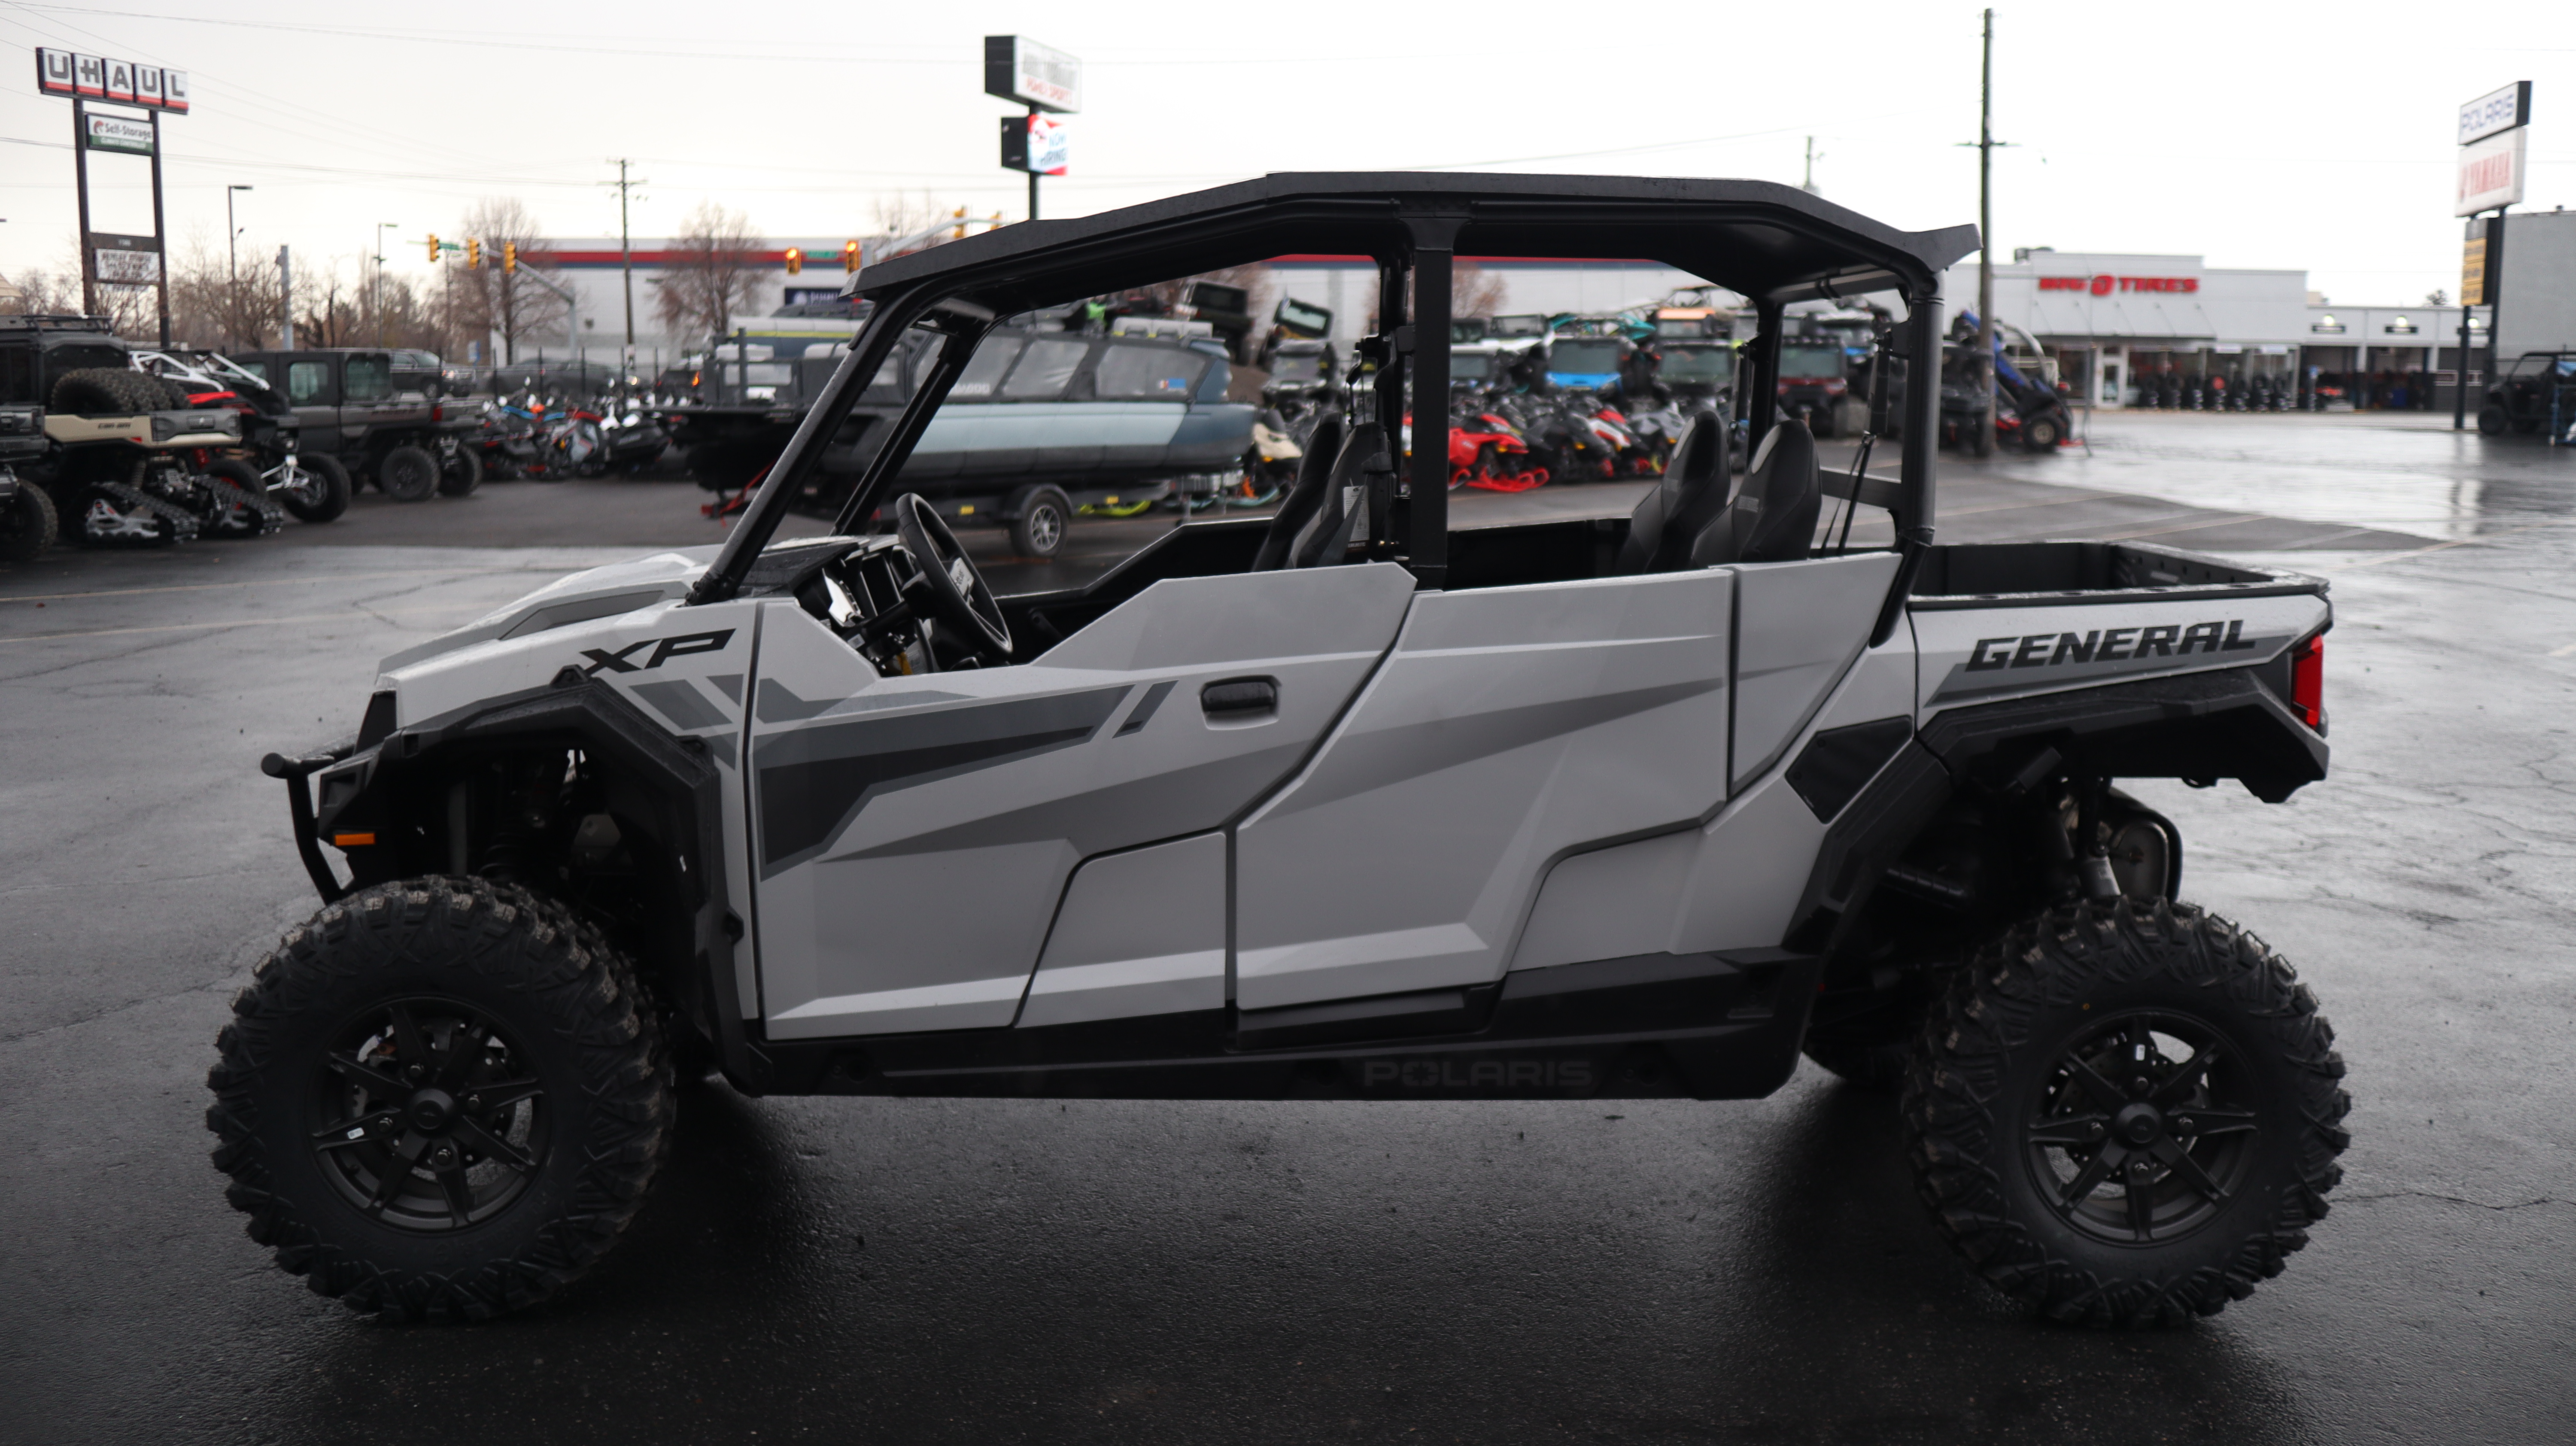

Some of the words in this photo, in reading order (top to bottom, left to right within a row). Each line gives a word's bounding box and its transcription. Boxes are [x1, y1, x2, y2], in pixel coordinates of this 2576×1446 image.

[2461, 94, 2514, 134] POLARIS
[2470, 151, 2511, 198] YAMAHA
[2039, 278, 2087, 291] BIG
[2119, 278, 2199, 292] TIRES
[579, 628, 736, 676] XP
[1965, 620, 2257, 672] GENERAL
[1364, 1061, 1592, 1087] POLARIS
